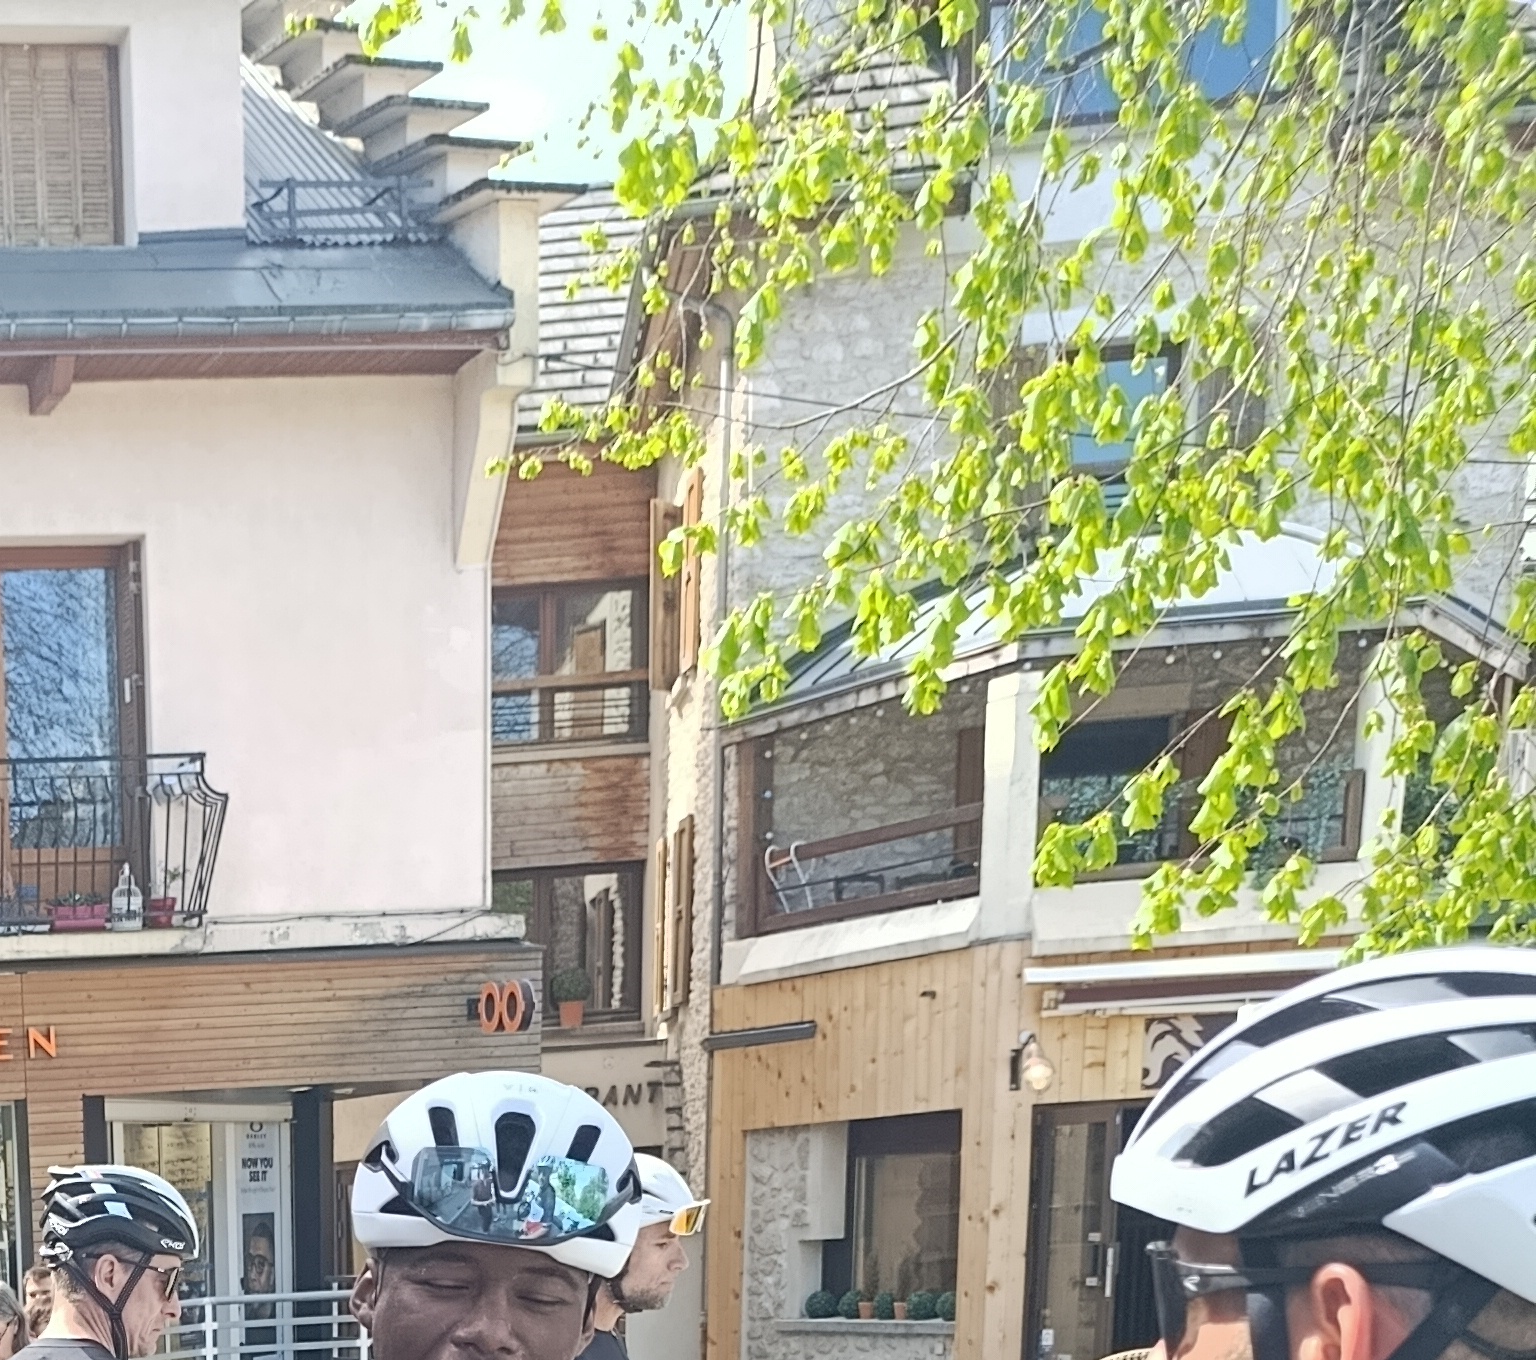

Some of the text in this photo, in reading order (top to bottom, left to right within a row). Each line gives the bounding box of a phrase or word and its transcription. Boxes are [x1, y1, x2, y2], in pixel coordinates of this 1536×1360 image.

[1244, 1101, 1407, 1199] LAZER
[242, 1157, 273, 1169] NOW YOU
[249, 1170, 268, 1182] SEE IT
